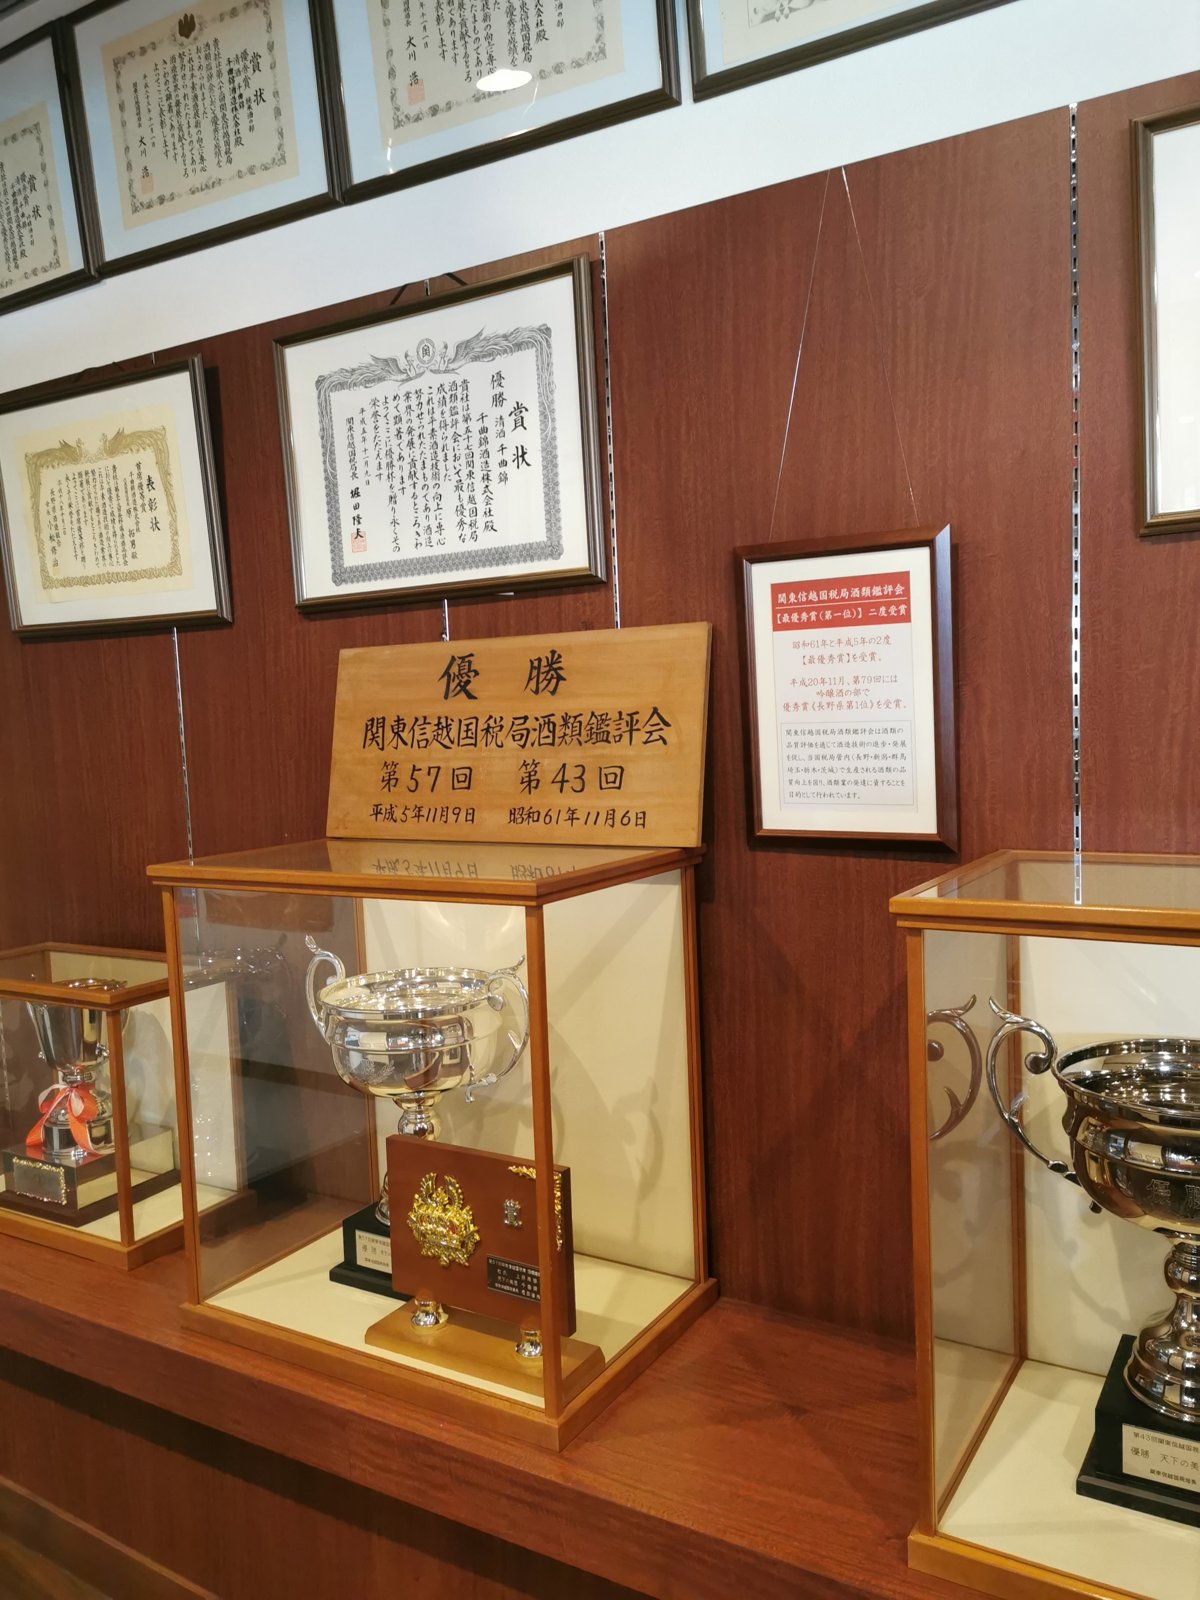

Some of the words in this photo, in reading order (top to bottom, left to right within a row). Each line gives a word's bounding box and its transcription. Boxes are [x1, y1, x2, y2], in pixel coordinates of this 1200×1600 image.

[250, 52, 266, 106] 賞状
[490, 370, 507, 408] 優勝
[359, 407, 371, 486] 平成五年十一月九日
[437, 383, 452, 482] 成績を得られました
[494, 415, 506, 438] 清酒
[508, 401, 532, 469] 賞状
[476, 412, 498, 533] 千曲錦酒造株式会社殿
[497, 443, 509, 486] 千曲錦
[146, 474, 160, 532] 表彰状
[777, 583, 905, 604] 関東信越国税局酒類鑑評会
[868, 604, 907, 617] 二度受賞
[792, 634, 892, 650] 昭和61年と平成5年の2度
[802, 651, 882, 665] 【最優秀賞】を受賞。
[437, 650, 567, 700] 優勝
[816, 688, 870, 699] 吟醸酒の部で
[362, 706, 672, 751] 関東信越国税局酒類鑑評会
[380, 760, 473, 793] 第57回
[518, 758, 625, 795] 第43回
[369, 803, 475, 825] 平成5年11月9日
[508, 806, 646, 829] 昭和61年11月6日
